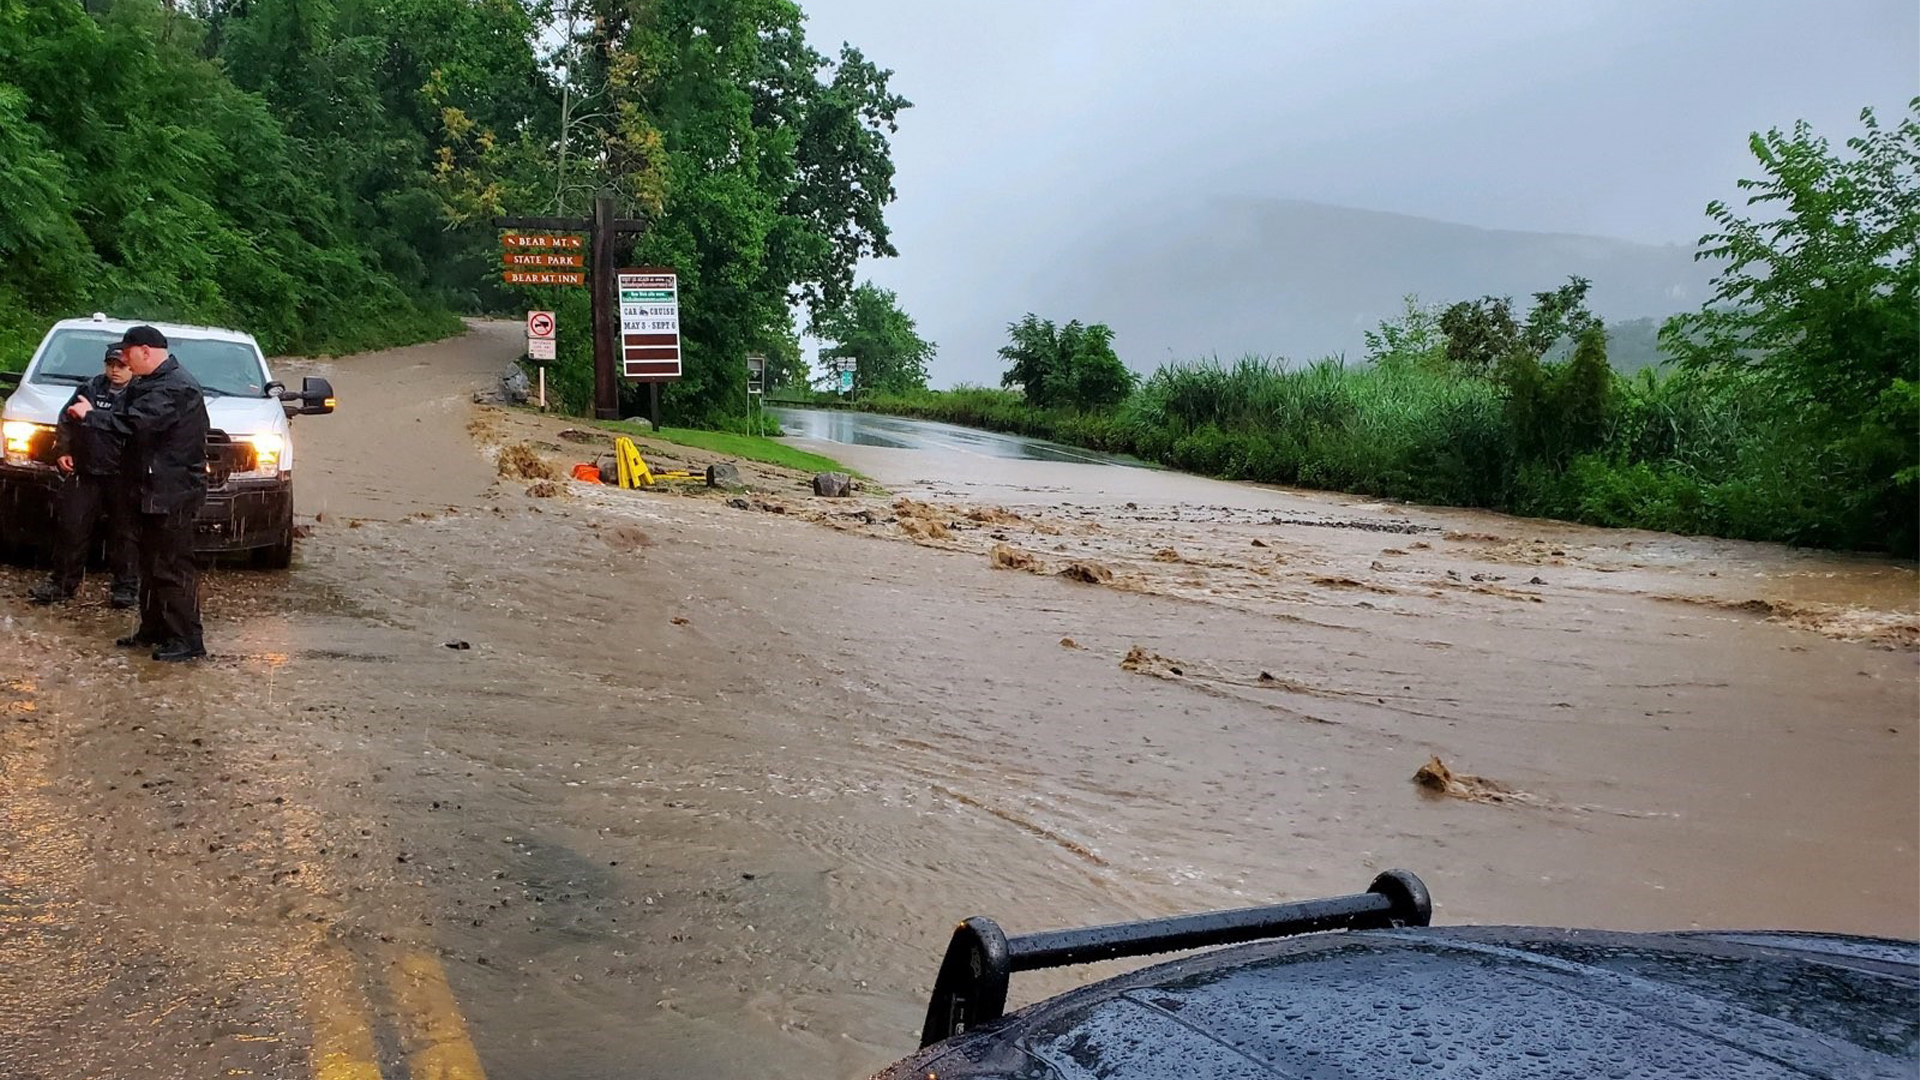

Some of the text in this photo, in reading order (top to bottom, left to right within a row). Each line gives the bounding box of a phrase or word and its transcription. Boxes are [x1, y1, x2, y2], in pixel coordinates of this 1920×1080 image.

[518, 237, 570, 247] BEAR MT.
[513, 255, 574, 265] STATE PARK
[511, 273, 538, 282] BEAR
[558, 274, 578, 283] INN
[624, 308, 675, 316] CAR CRUISE
[624, 321, 640, 330] MAY
[652, 321, 670, 330] SEPT
[671, 321, 676, 330] 6
